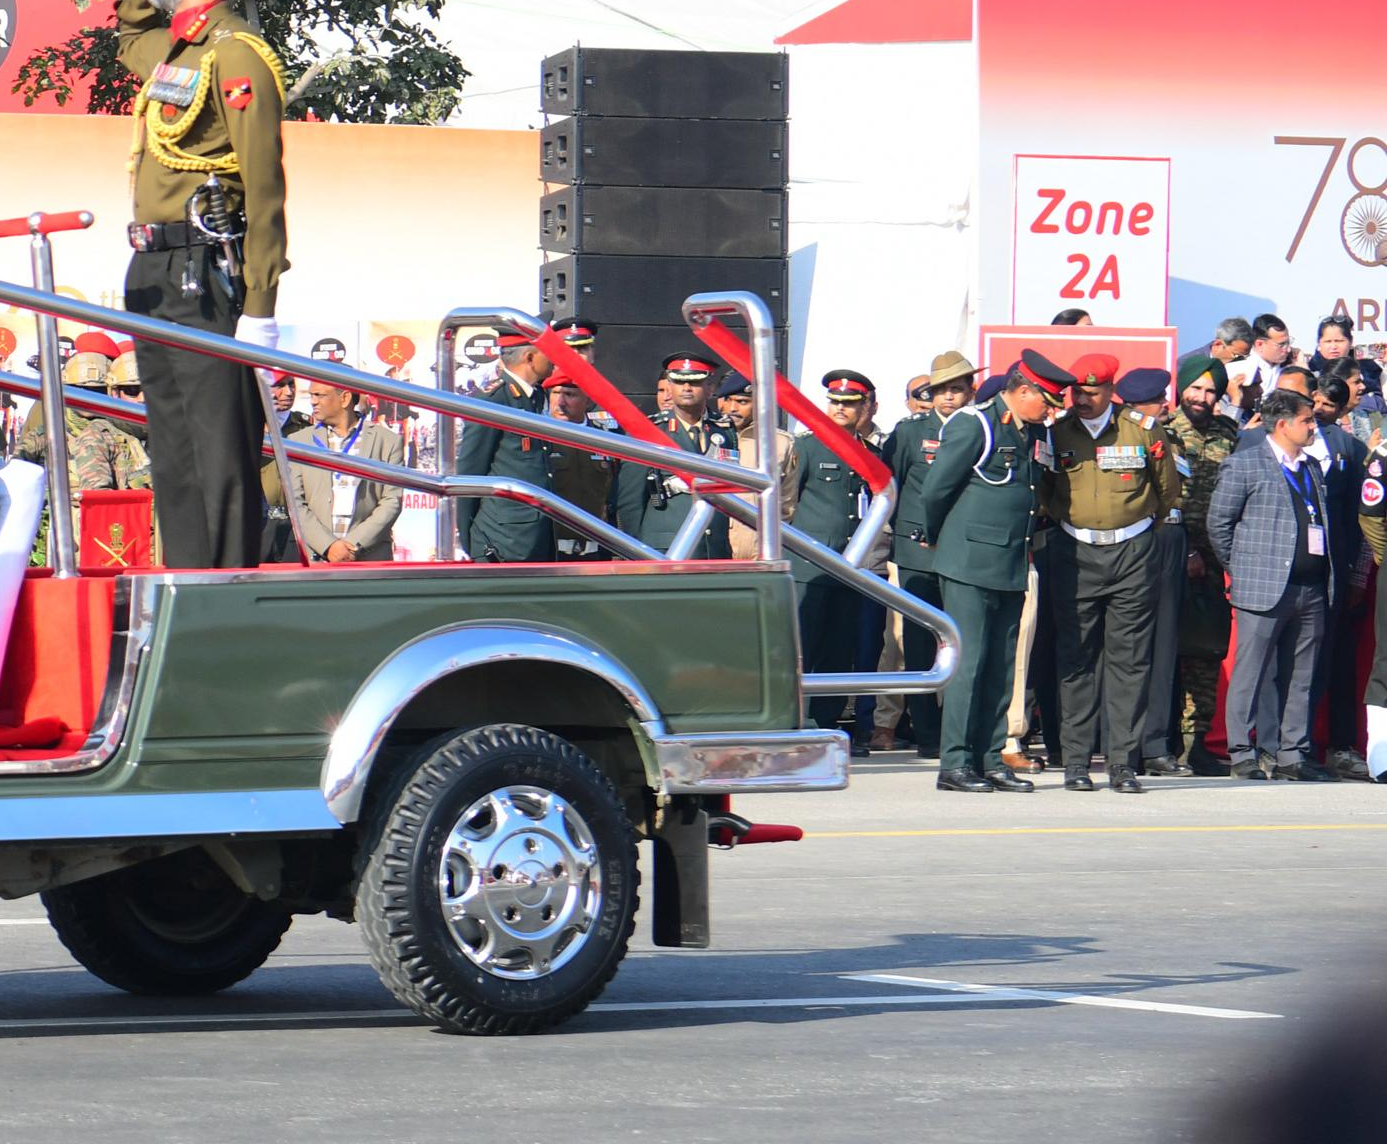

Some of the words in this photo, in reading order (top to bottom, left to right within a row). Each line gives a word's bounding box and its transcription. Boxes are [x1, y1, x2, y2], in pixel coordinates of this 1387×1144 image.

[1030, 188, 1154, 236] Zone
[1059, 253, 1121, 300] 2A
[1331, 298, 1387, 332] AR
[402, 494, 437, 509] ARAD
